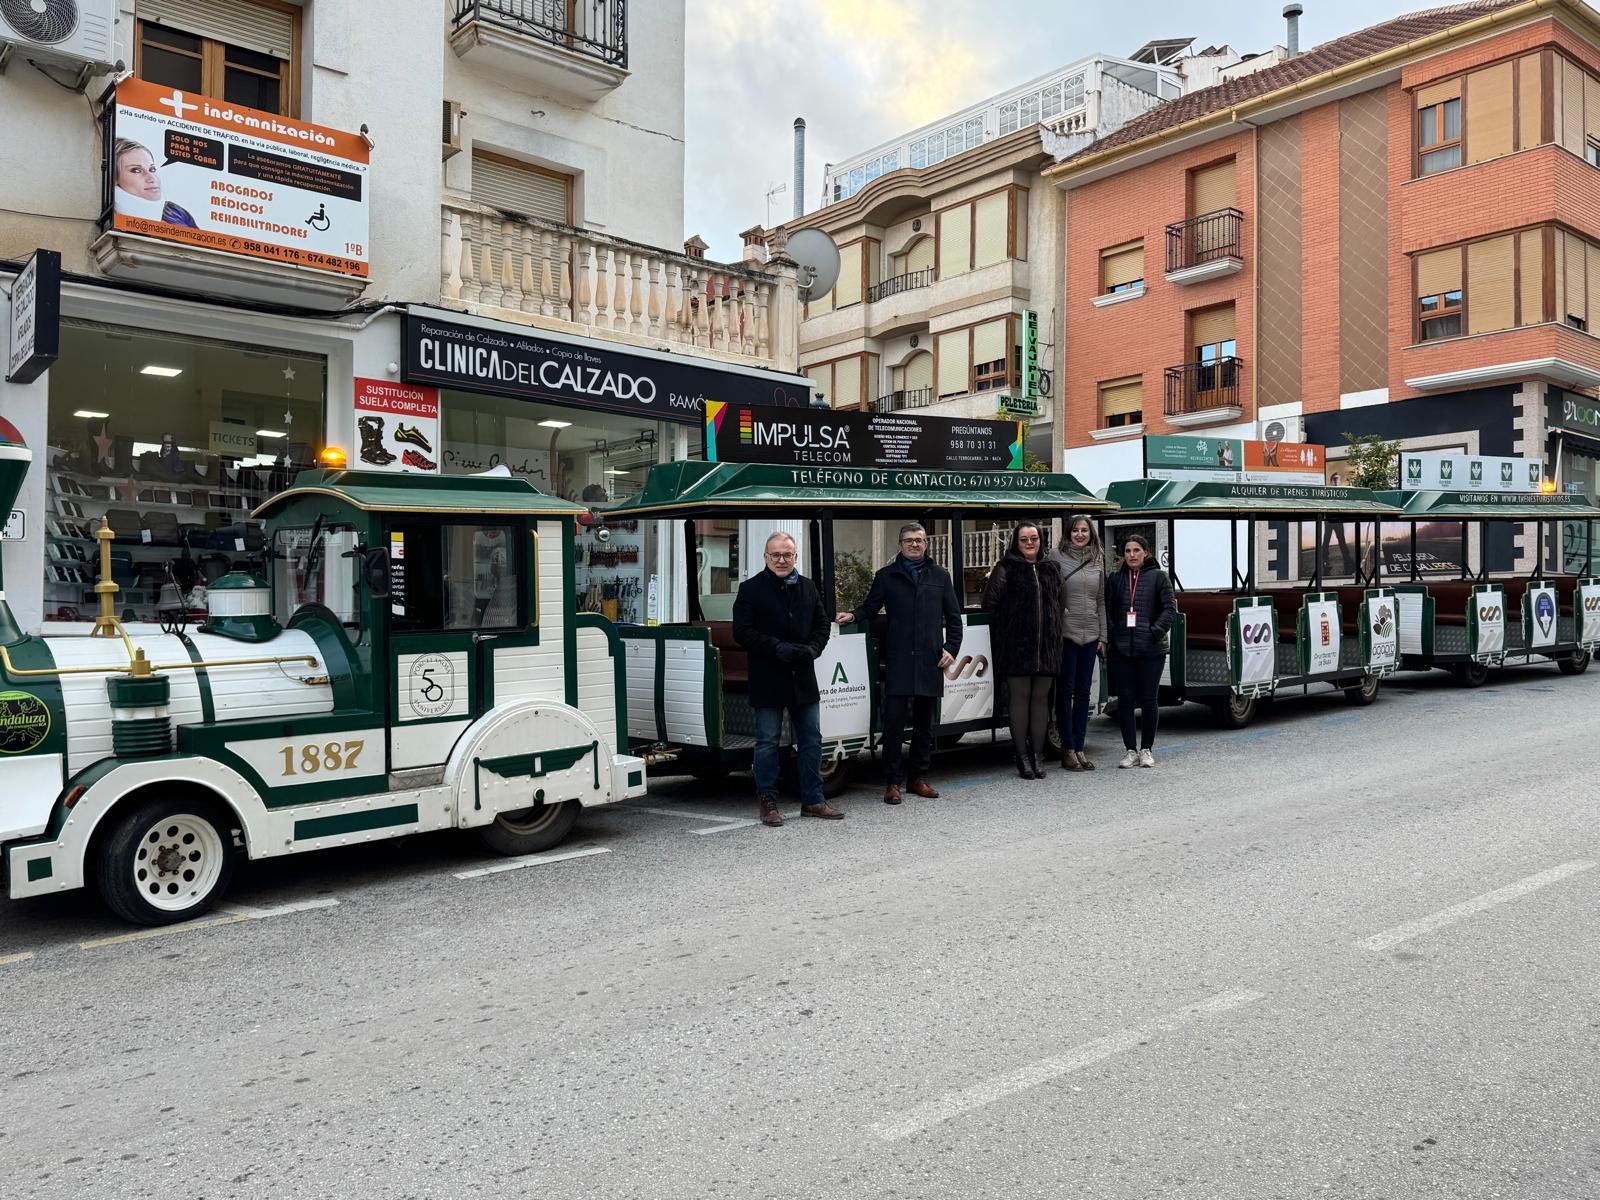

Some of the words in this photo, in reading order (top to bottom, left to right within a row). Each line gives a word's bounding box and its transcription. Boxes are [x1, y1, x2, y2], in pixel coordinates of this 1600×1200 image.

[134, 112, 157, 123] sufrido
[167, 120, 202, 133] ACCIDENTE
[204, 103, 336, 147] indemnización
[170, 134, 190, 144] SOLO
[193, 140, 208, 148] NOS
[170, 149, 191, 159] USTED
[194, 155, 217, 165] COBRA
[233, 158, 248, 166] para
[293, 164, 342, 180] GRATUITAMENTE
[211, 180, 273, 202] ABOGADOS
[211, 195, 264, 215] MÉDICOS
[211, 211, 308, 239] REHABILITADORES
[243, 241, 261, 252] 958
[264, 245, 280, 255] 041
[283, 249, 300, 259] 176
[308, 253, 324, 264] 674
[326, 256, 342, 267] 482
[344, 261, 360, 271] 196
[421, 324, 464, 340] Reparación
[464, 331, 475, 342] de
[476, 334, 508, 348] Calzado
[551, 347, 573, 360] Copia
[573, 351, 583, 361] de
[366, 385, 424, 400] SUSTITUCIÓN
[359, 395, 389, 408] SUELA
[391, 400, 438, 413] COMPLETA
[669, 393, 704, 412] RAMÓ
[1000, 396, 1038, 411] PELETERIA
[951, 425, 993, 435] PREGÚNTANOS
[211, 432, 255, 447] TICKETS
[950, 440, 964, 449] 958
[966, 440, 975, 449] 70
[977, 440, 986, 449] 31
[988, 441, 996, 449] 31
[793, 450, 851, 463] TELECOM
[489, 454, 546, 480] Crdin
[791, 468, 863, 484] TELÉFONO
[872, 473, 888, 485] DE
[895, 473, 967, 487] CONTACTO:
[970, 475, 990, 487] 670
[993, 475, 1013, 487] 957
[1016, 475, 1046, 488] 025/6
[1231, 486, 1267, 496] ALQUILER
[1270, 487, 1280, 496] DE
[1491, 494, 1498, 503] EN
[1390, 563, 1402, 571] DE
[279, 740, 364, 776] 1887
